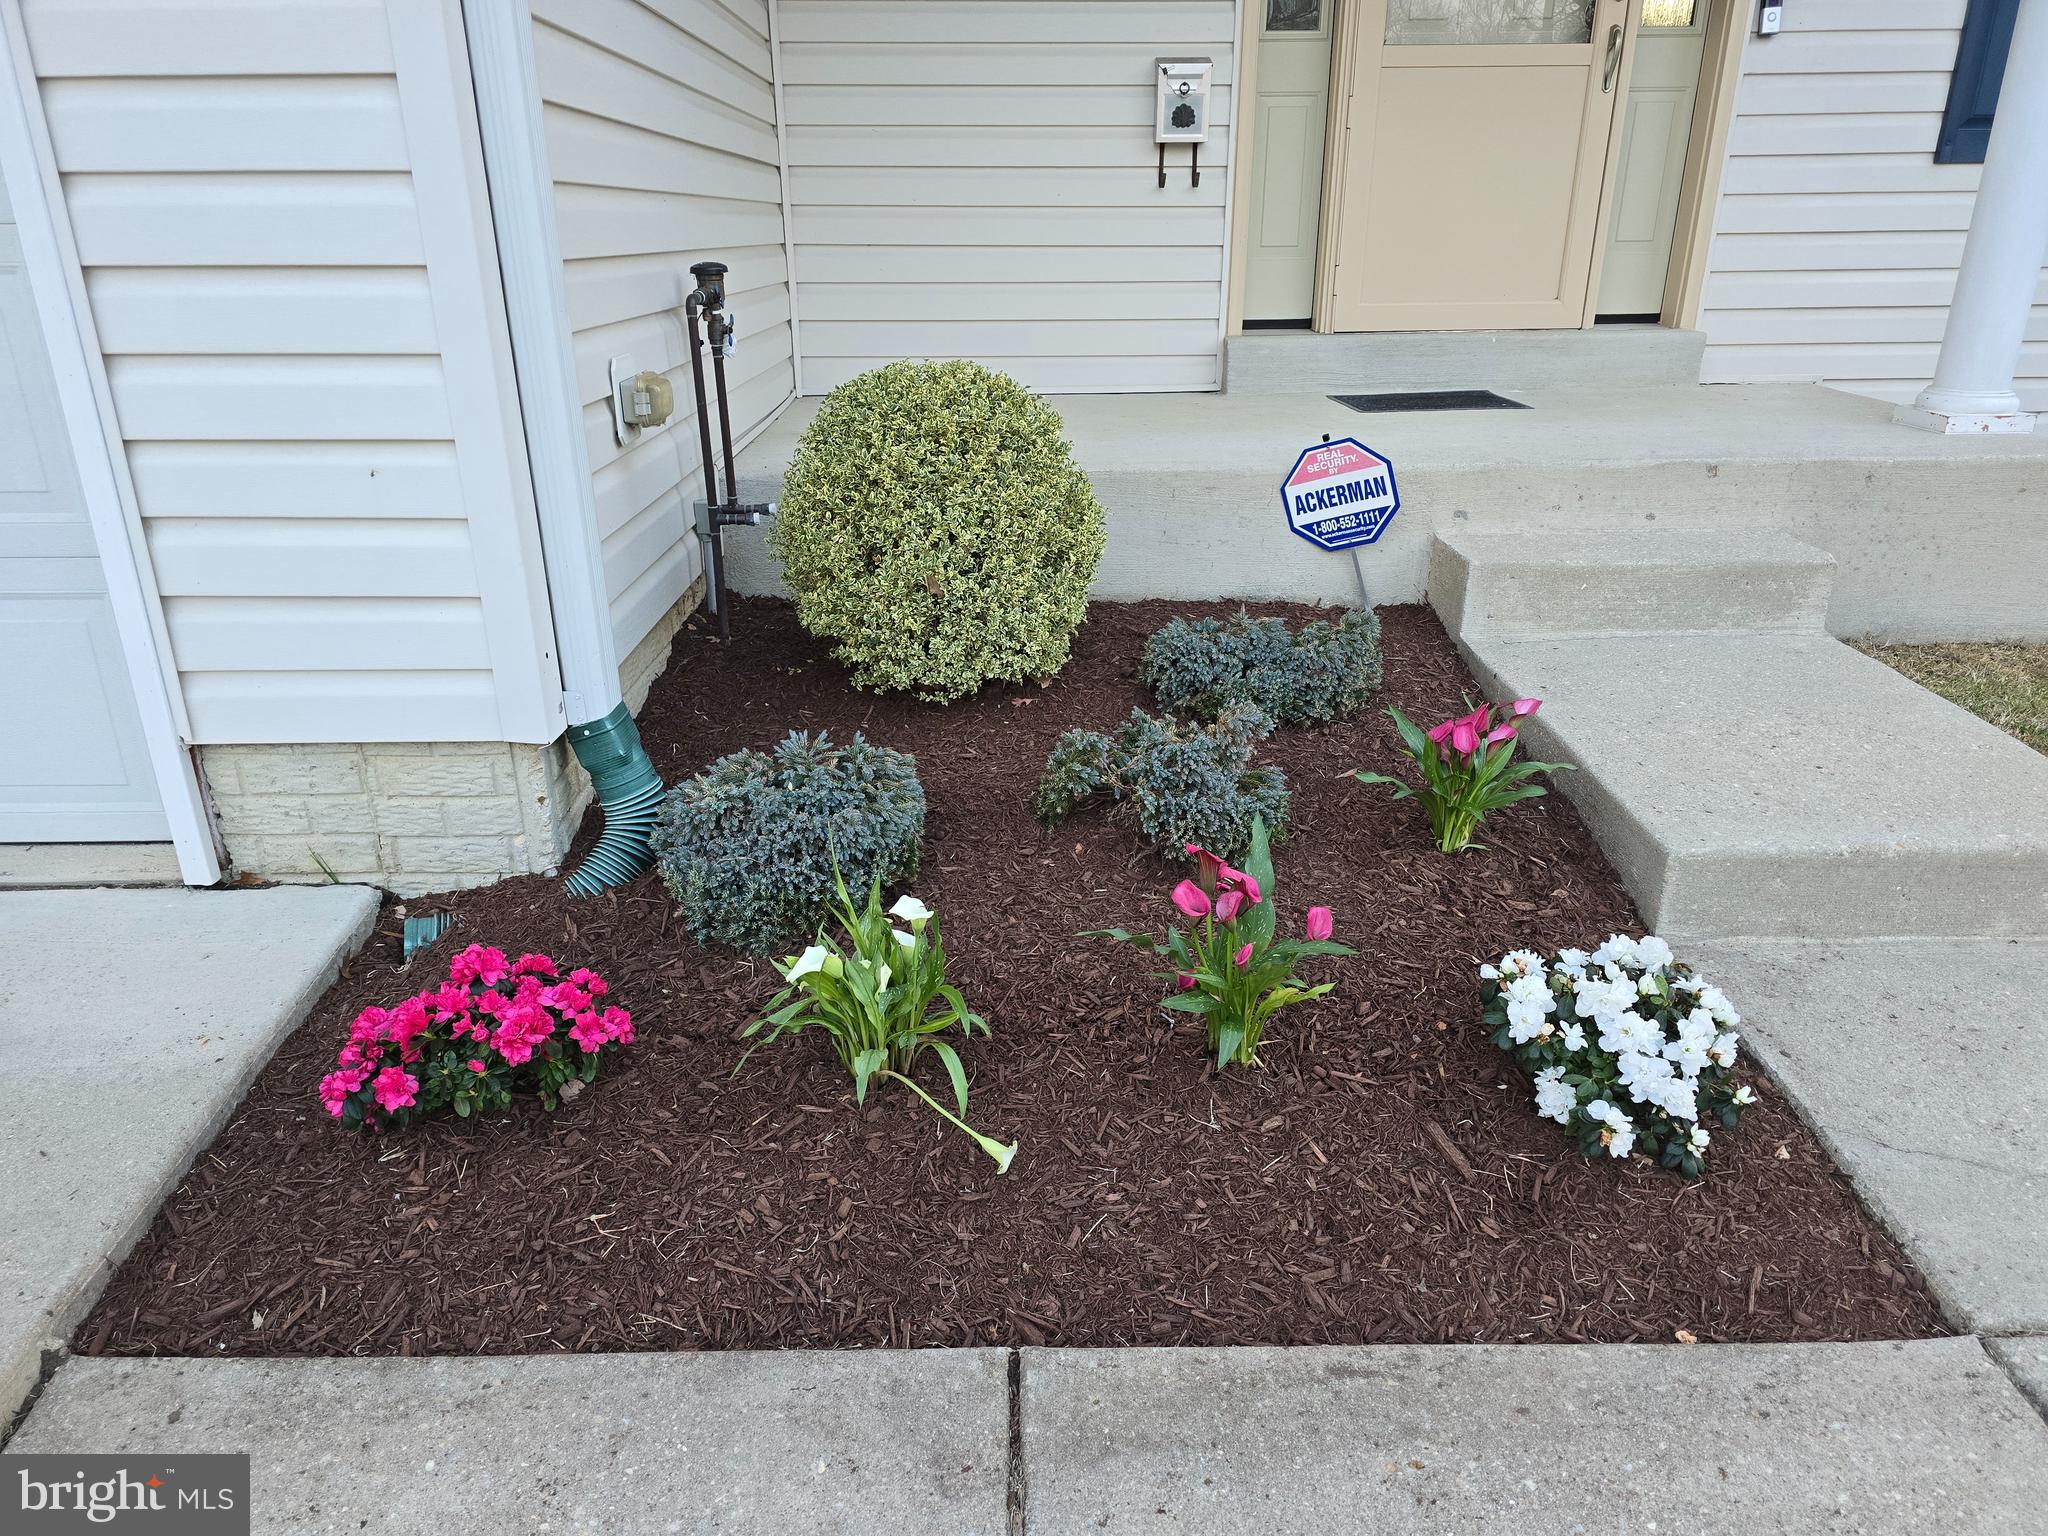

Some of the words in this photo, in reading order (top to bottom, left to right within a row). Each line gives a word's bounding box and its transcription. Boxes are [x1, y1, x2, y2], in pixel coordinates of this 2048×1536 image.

[1317, 450, 1344, 462] REAL
[1295, 476, 1387, 515] ACKERMAN
[1312, 510, 1380, 535] 1-800-552-1111
